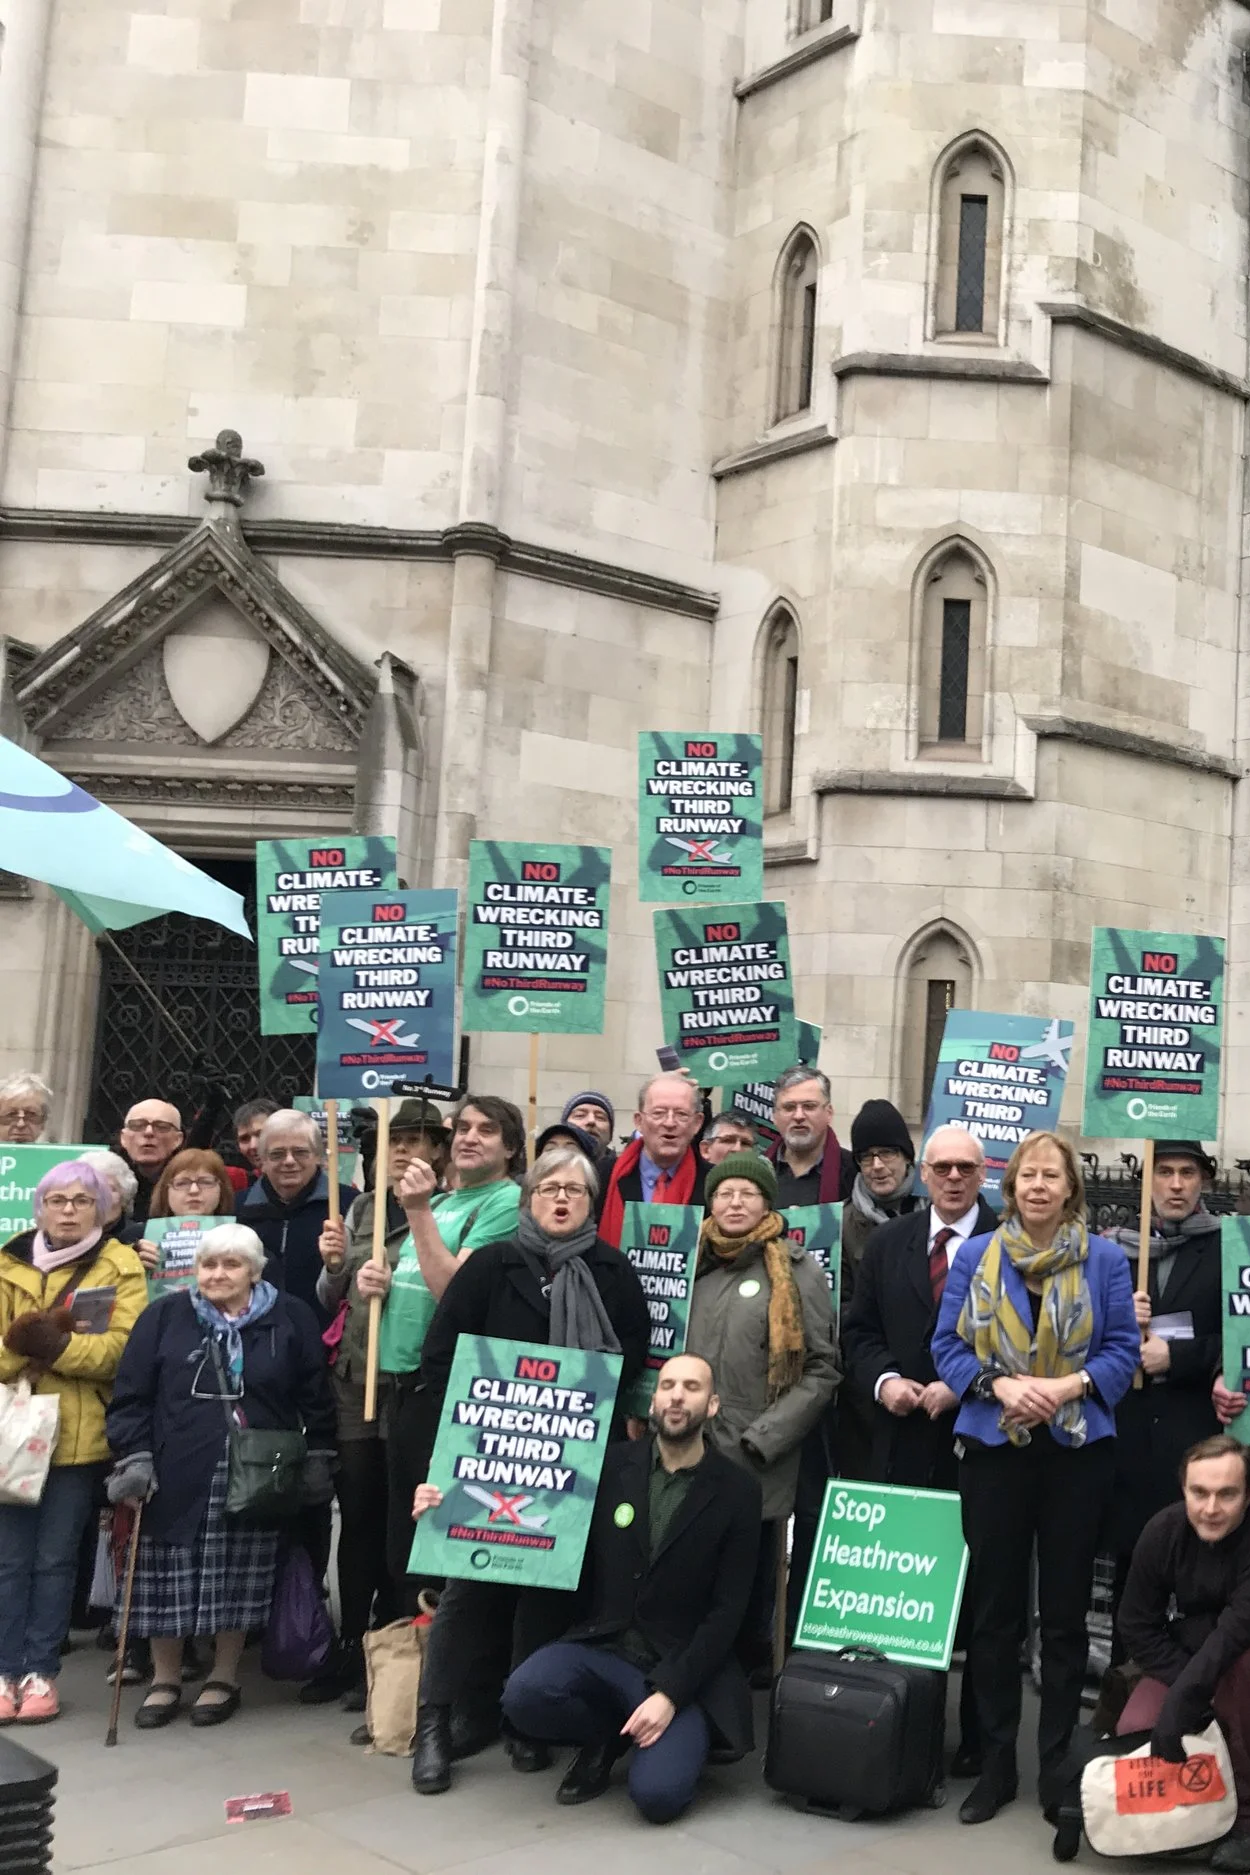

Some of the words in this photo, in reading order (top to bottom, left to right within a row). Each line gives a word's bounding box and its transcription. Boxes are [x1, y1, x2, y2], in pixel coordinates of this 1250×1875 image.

[687, 743, 715, 757] NO
[656, 761, 749, 777] CLIMATE-
[648, 780, 753, 796] WRECKING
[671, 799, 731, 815] THIRD
[659, 818, 743, 833] RUNWAY
[311, 849, 344, 867] NO
[277, 869, 382, 890] CLIMATE-
[524, 863, 558, 881] NO
[486, 884, 596, 905] CLIMATE-
[373, 905, 405, 922] NO
[476, 905, 601, 927] WRECKING
[341, 925, 438, 945] CLIMATE-
[502, 929, 573, 948] THIRD
[706, 925, 739, 942] NO
[333, 946, 443, 967] WRECKING
[486, 951, 587, 971] RUNWAY
[674, 942, 777, 966] CLIMATE-
[1143, 954, 1175, 973] NO
[355, 969, 419, 987] THIRD
[666, 963, 785, 988] WRECKING
[693, 986, 761, 1006] THIRD
[1107, 975, 1211, 999] CLIMATE-
[342, 990, 431, 1010] RUNWAY
[681, 1005, 776, 1030] RUNWAY
[1098, 999, 1216, 1025] WRECKING
[1122, 1025, 1190, 1047] THIRD
[991, 1044, 1019, 1061] NO
[1106, 1049, 1202, 1071] RUNWAY
[958, 1061, 1048, 1084] CLIMATE-
[948, 1079, 1049, 1106] WRECKING
[734, 1093, 775, 1121] RUNW
[964, 1101, 1023, 1122] THIRD
[649, 1225, 669, 1245] NO
[640, 1275, 687, 1298] ECKING
[518, 1359, 556, 1381] NO
[472, 1379, 595, 1414] CLIMATE-
[456, 1402, 596, 1441] WRECKING
[481, 1434, 561, 1463] THIRD
[457, 1457, 573, 1491] RUNWAY
[831, 1490, 887, 1532] Stop
[450, 1527, 554, 1549] #NoThirdRunway
[822, 1533, 938, 1577] Heathrow
[812, 1577, 935, 1624] Expansion
[803, 1621, 945, 1654] stopheathrowexpansion.co.uk
[1128, 1780, 1166, 1799] LIFE
